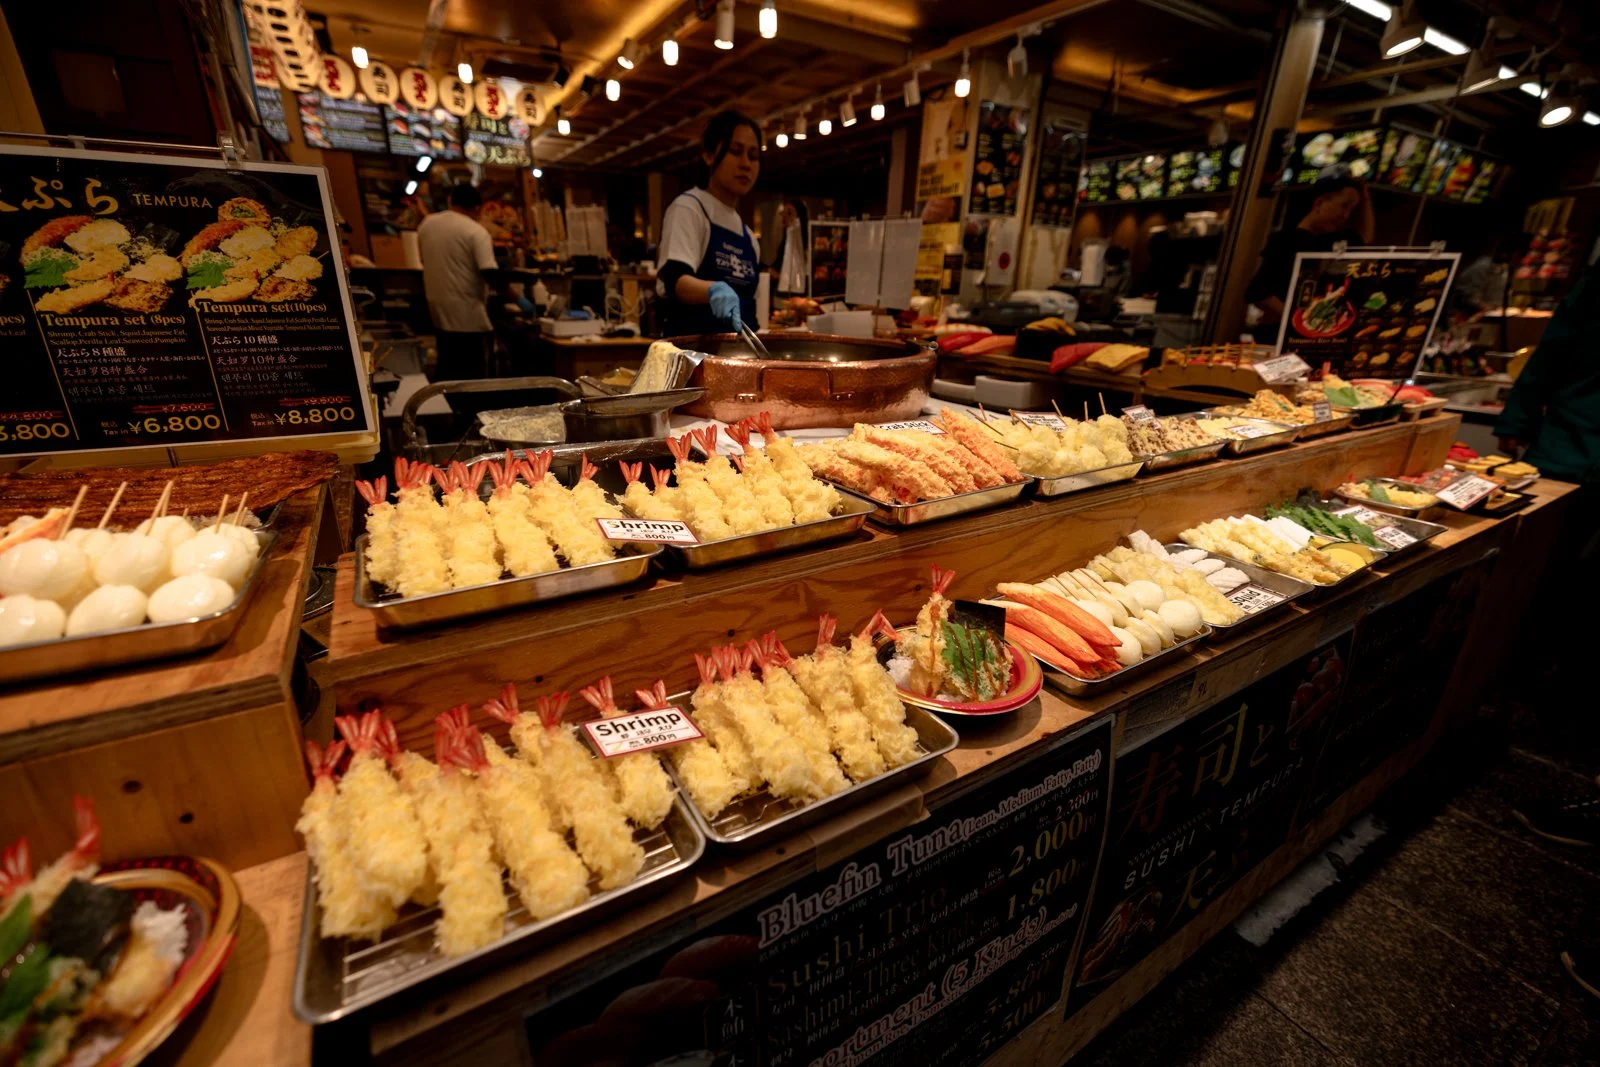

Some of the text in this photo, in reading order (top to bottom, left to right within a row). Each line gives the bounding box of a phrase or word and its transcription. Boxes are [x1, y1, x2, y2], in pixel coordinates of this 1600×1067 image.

[0, 175, 119, 215] ぷら
[131, 192, 213, 209] TEMPURA
[198, 300, 267, 316] Tempura
[40, 312, 187, 329] Tempura set (8pcs)
[127, 413, 221, 434] ¥6,800
[273, 406, 356, 426] ¥8,800
[606, 520, 684, 533] Shrimp
[595, 712, 681, 736] Shrimp
[642, 733, 678, 745] 800円
[757, 861, 883, 949] Bluefin
[999, 784, 1045, 818] Medium
[1072, 749, 1102, 778] Fatty)
[1124, 827, 1197, 892] SUSHI
[767, 922, 866, 995] Sushi
[942, 957, 970, 1001] (5
[974, 904, 1047, 972] Kinds)
